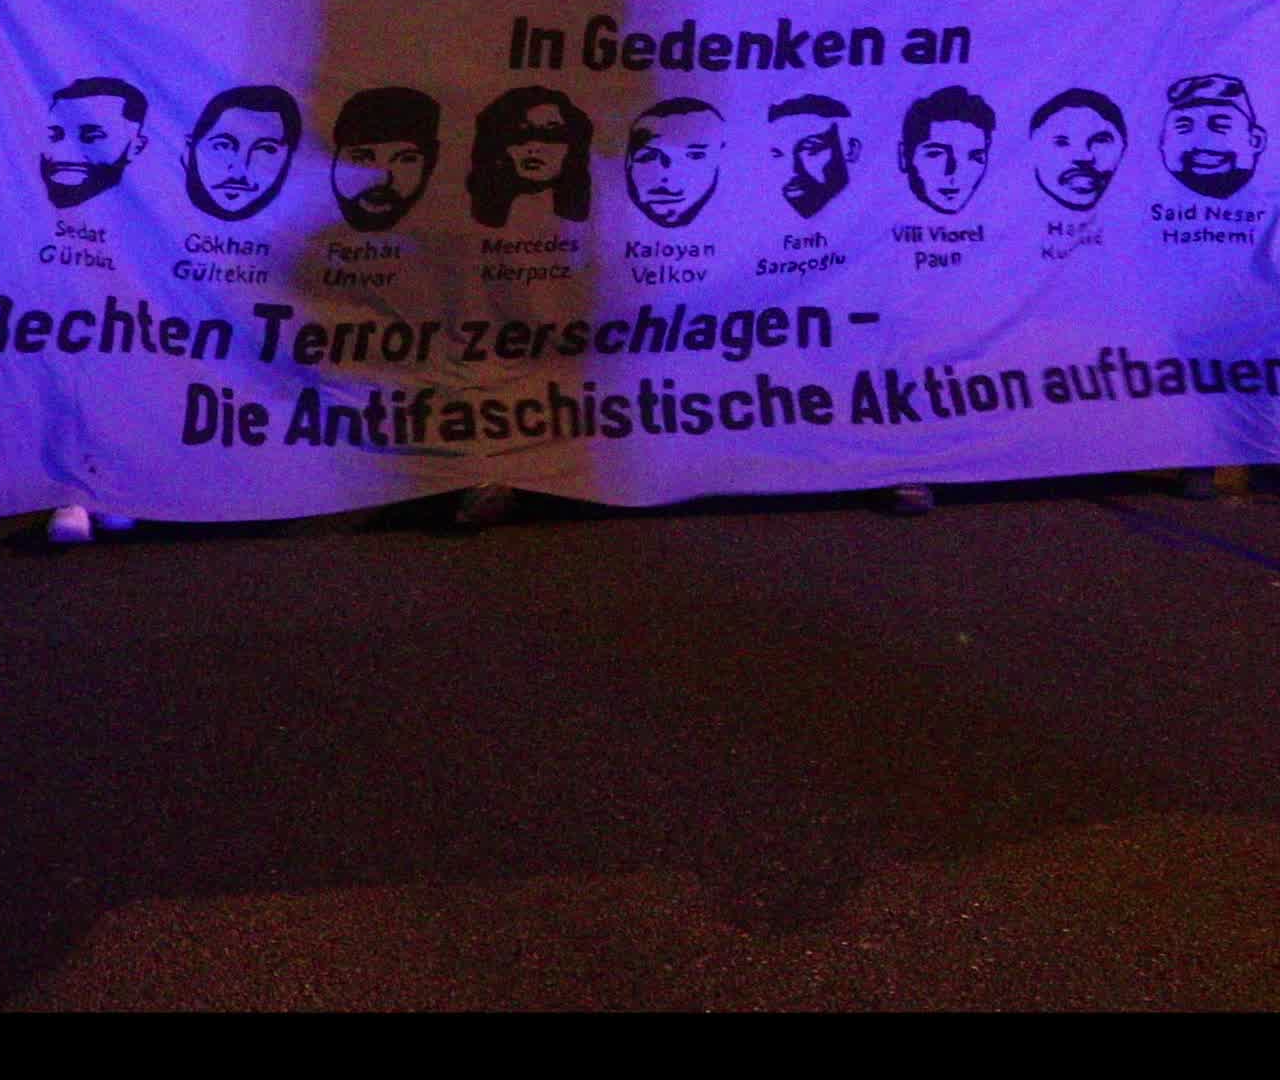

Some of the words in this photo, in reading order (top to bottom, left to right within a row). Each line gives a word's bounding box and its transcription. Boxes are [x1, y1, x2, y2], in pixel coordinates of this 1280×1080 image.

[509, 16, 565, 70] In
[581, 14, 886, 72] Gedenken
[901, 25, 970, 65] an
[1150, 203, 1197, 221] Said
[1205, 206, 1266, 223] Nesar
[55, 220, 106, 244] Sedat
[928, 224, 984, 243] Viorel
[1162, 228, 1256, 246] Hashemi
[184, 232, 270, 257] Gökhan
[481, 236, 579, 255] Mercedes
[625, 240, 716, 259] Kaloyan
[172, 259, 269, 286] Gültekin
[631, 266, 707, 285] Velkov
[253, 303, 442, 364] Terror
[460, 303, 832, 362] zerschlagen
[181, 382, 270, 447] Die
[284, 372, 834, 447] Antifaschistische
[849, 364, 1033, 426] Aktion
